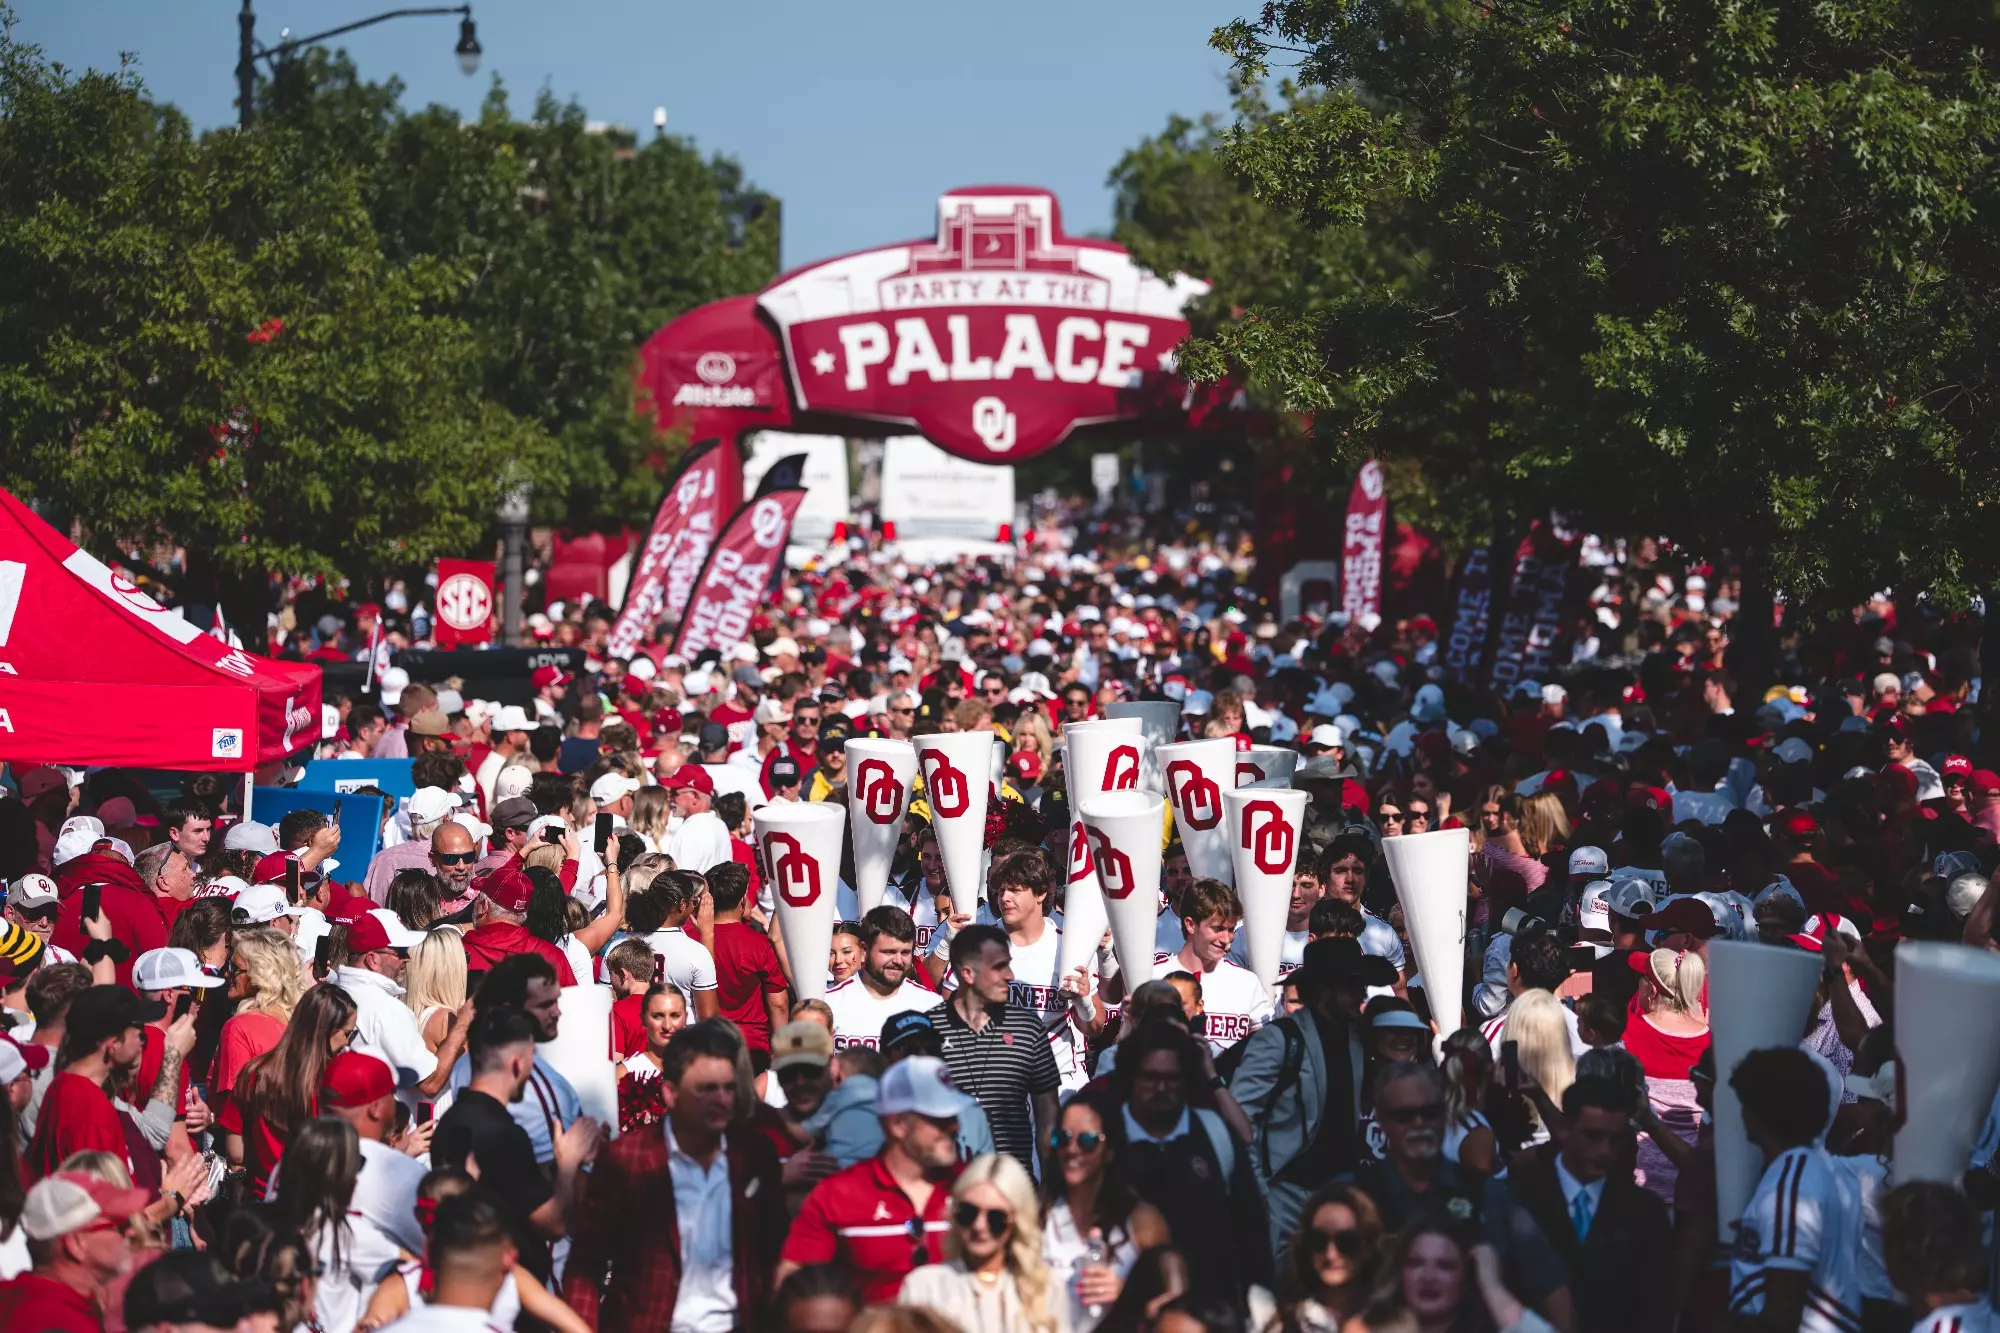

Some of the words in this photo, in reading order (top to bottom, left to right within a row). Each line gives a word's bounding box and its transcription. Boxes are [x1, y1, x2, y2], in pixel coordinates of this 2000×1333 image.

[893, 278, 981, 301] PARTY
[999, 278, 1031, 300] AT
[1044, 279, 1097, 302] THE
[838, 313, 1150, 391] PALACE
[671, 382, 756, 408] Allstate
[972, 396, 1017, 452] OU
[751, 498, 788, 549] OU
[441, 577, 488, 626] SEC
[855, 758, 905, 825] OU
[1166, 759, 1223, 832] OU
[1241, 800, 1295, 875] OU
[37, 878, 51, 893] OU
[762, 831, 822, 908] OU
